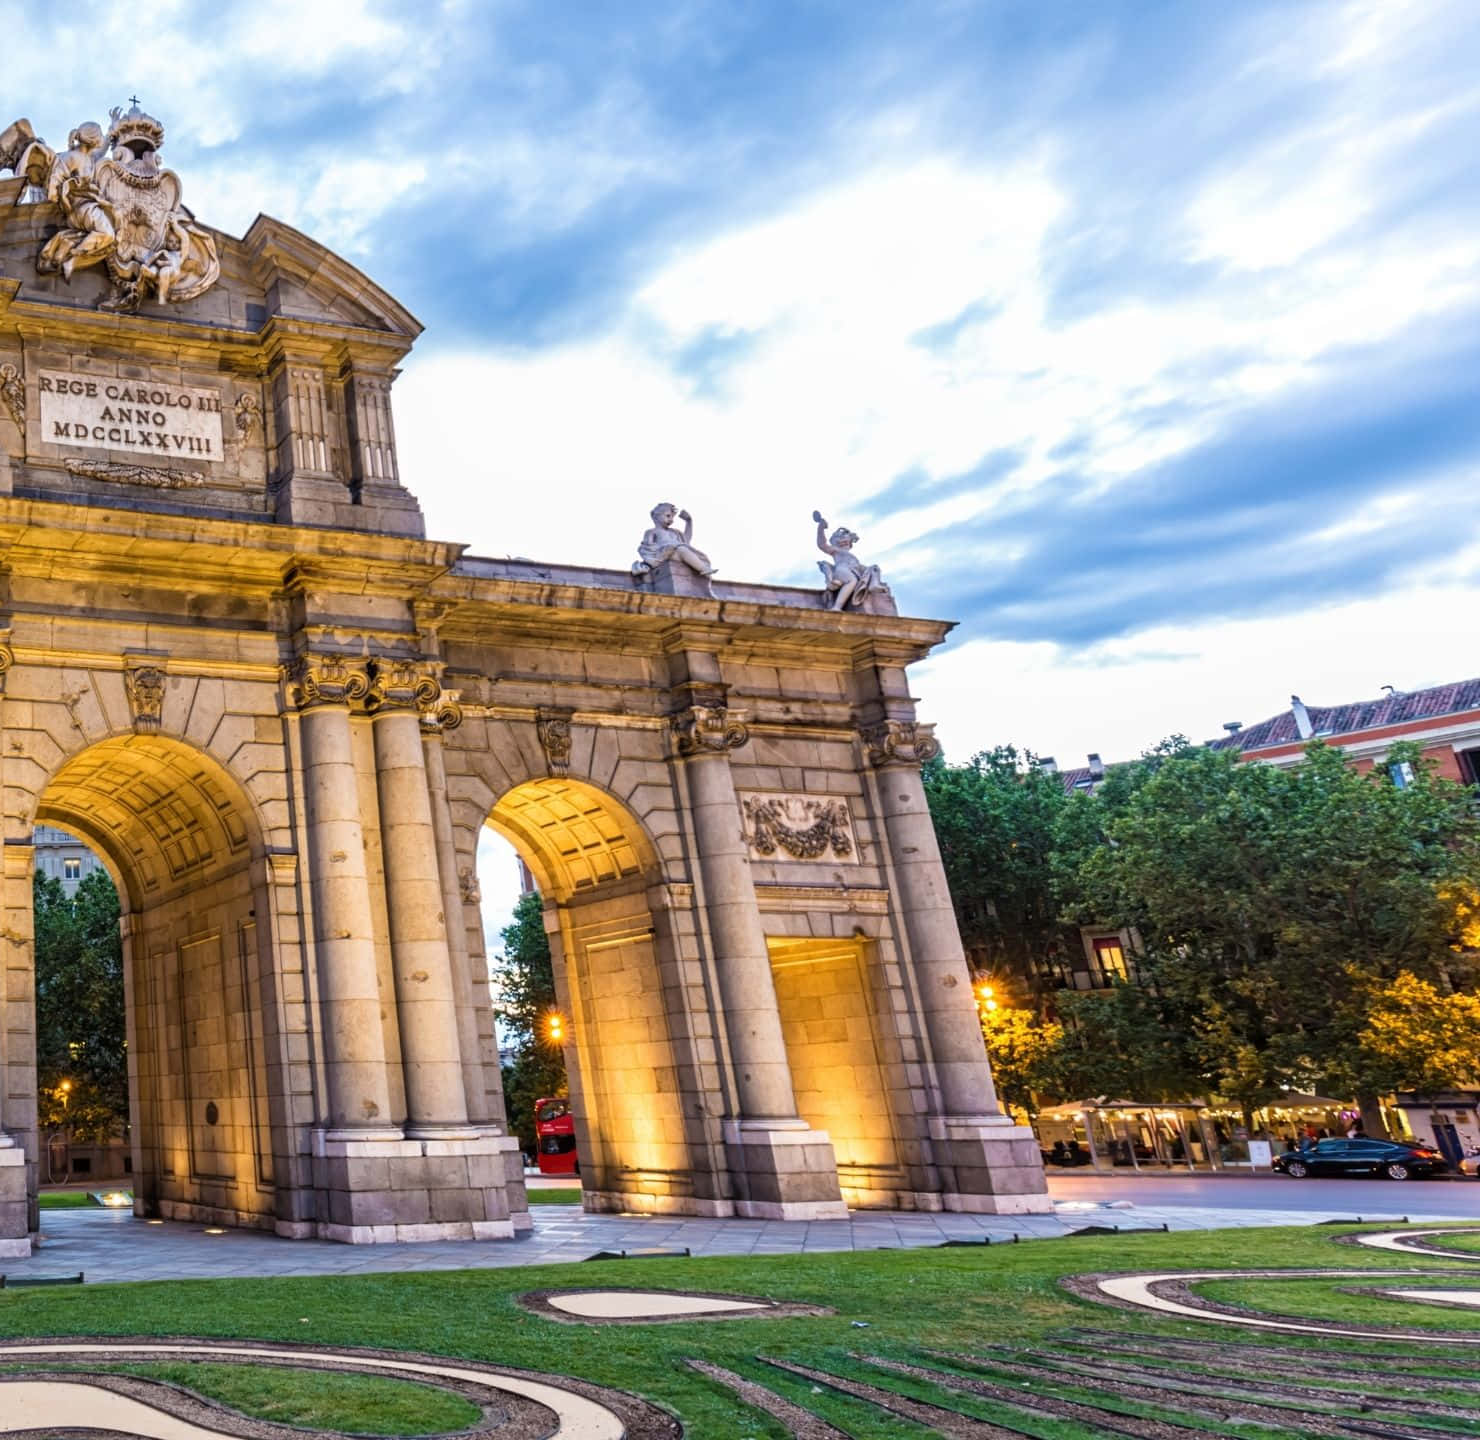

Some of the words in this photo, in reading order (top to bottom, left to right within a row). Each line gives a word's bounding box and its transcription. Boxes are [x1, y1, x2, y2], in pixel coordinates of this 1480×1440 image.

[39, 377, 98, 397] REGE
[105, 386, 191, 408] CAROLO
[198, 396, 222, 412] III
[100, 406, 166, 426] ANNO
[54, 421, 211, 452] MDCCLXXVIII
